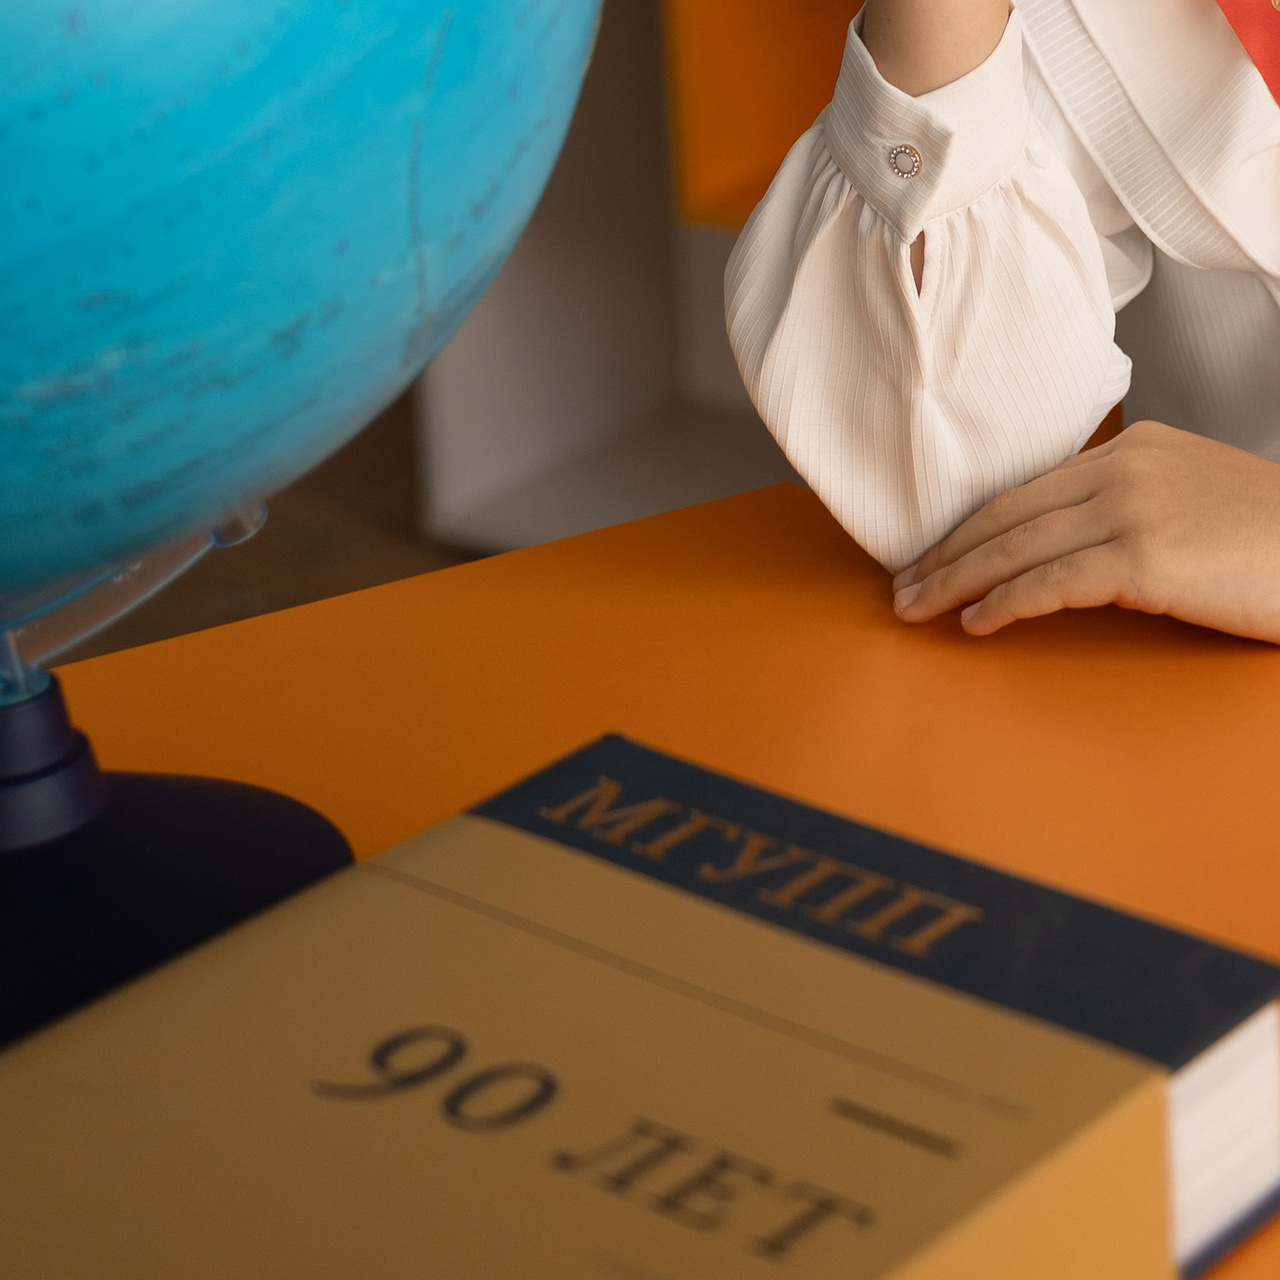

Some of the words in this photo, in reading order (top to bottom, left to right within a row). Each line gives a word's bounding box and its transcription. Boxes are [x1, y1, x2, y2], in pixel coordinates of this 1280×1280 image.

[538, 774, 984, 958] МГУПП
[308, 1024, 560, 1134] 90
[551, 1116, 876, 1262] ЛЕТ
